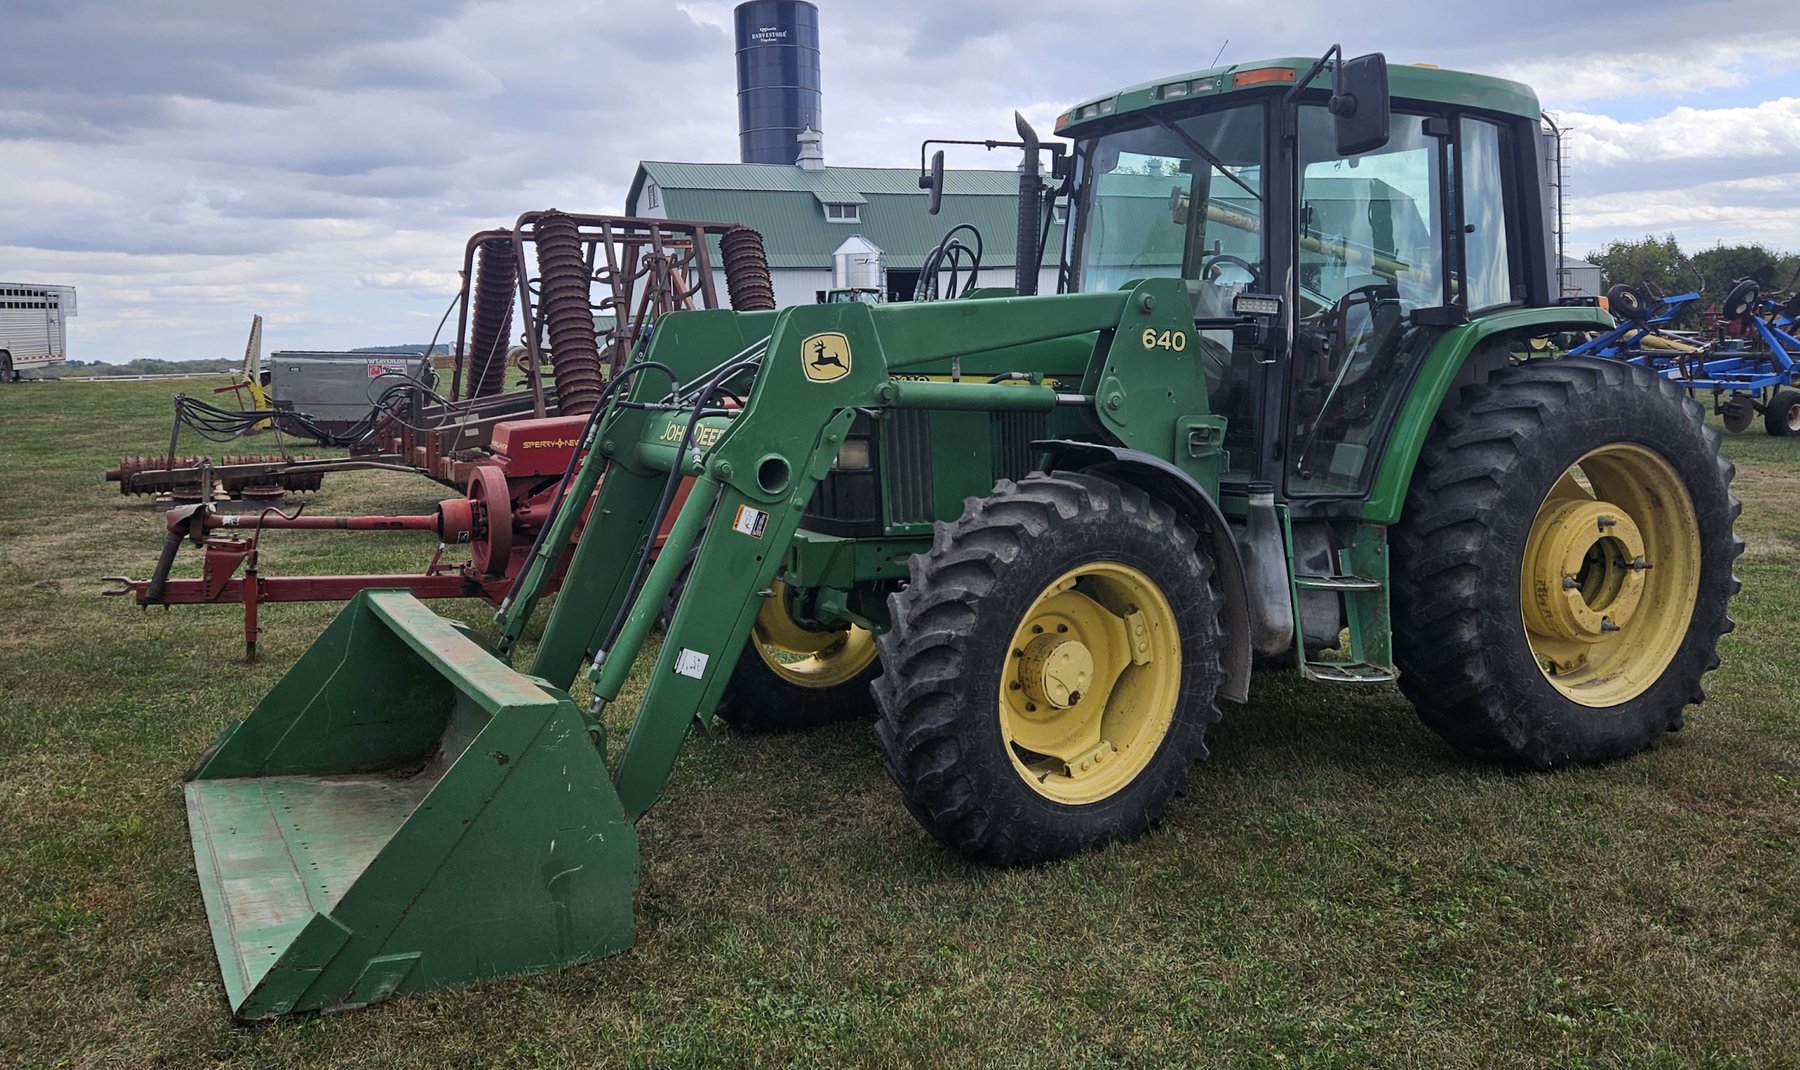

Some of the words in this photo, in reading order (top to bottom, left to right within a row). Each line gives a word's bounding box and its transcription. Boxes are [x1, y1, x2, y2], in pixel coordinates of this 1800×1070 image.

[1142, 328, 1186, 352] 640
[522, 441, 555, 449] SPERRY
[694, 423, 727, 446] DEE
